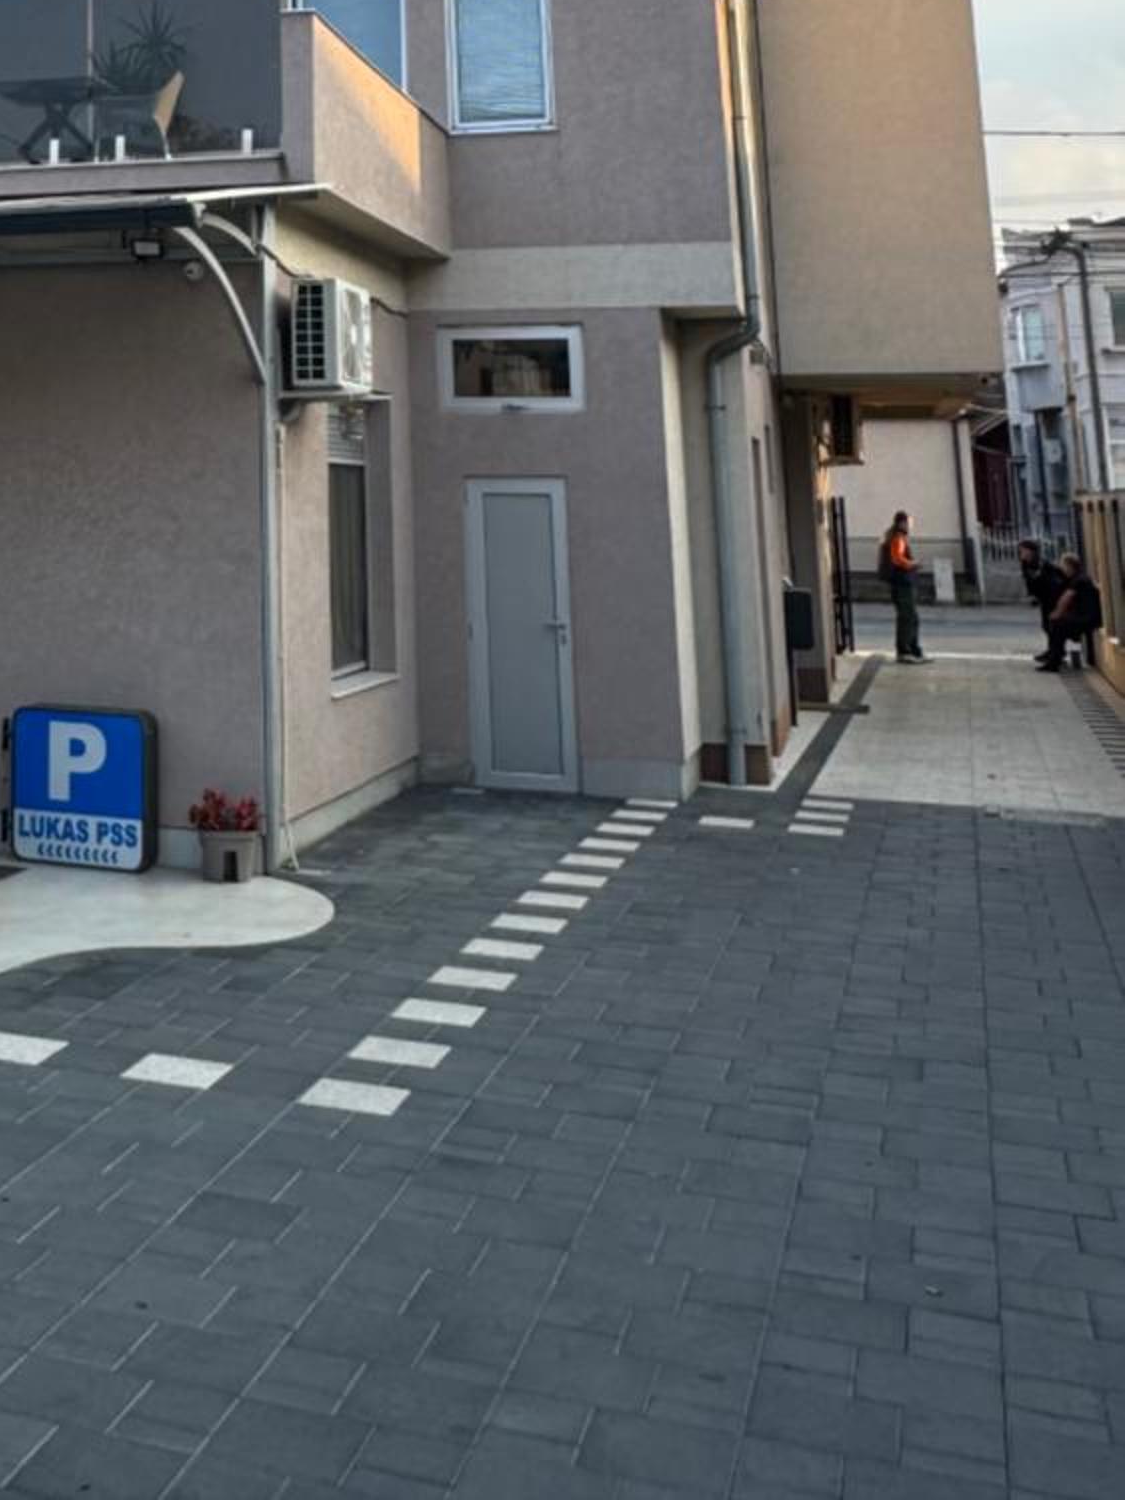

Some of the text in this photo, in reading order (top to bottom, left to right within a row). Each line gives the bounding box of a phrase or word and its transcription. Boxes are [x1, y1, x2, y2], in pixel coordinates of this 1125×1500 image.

[49, 720, 107, 801] P
[18, 813, 138, 848] LUKAS PSS
